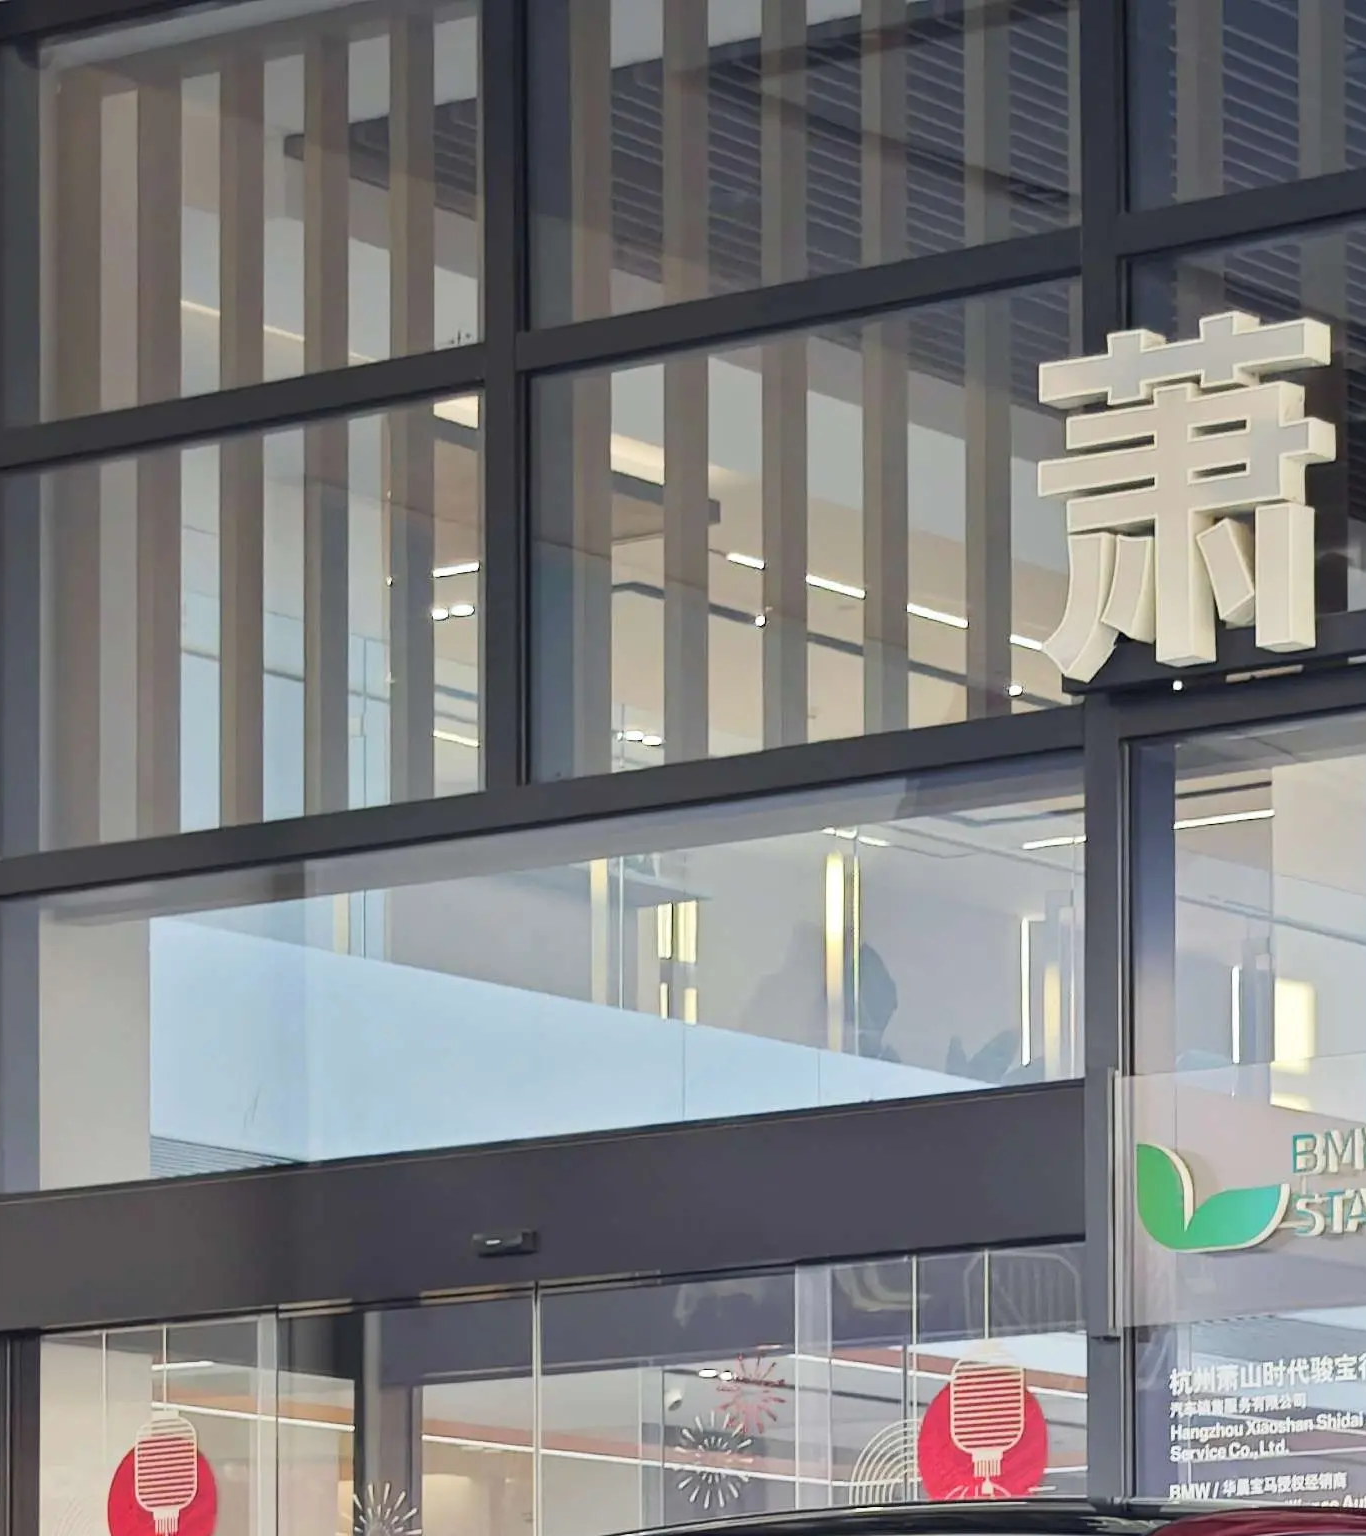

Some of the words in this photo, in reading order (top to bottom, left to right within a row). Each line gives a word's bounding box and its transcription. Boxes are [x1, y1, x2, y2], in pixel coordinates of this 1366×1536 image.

[1170, 1421, 1244, 1443] Hangzhou
[1245, 1415, 1314, 1437] Xiaoshan
[1316, 1410, 1363, 1430] Shidai
[1169, 1444, 1227, 1463] Service
[1169, 1481, 1212, 1503] BMW
